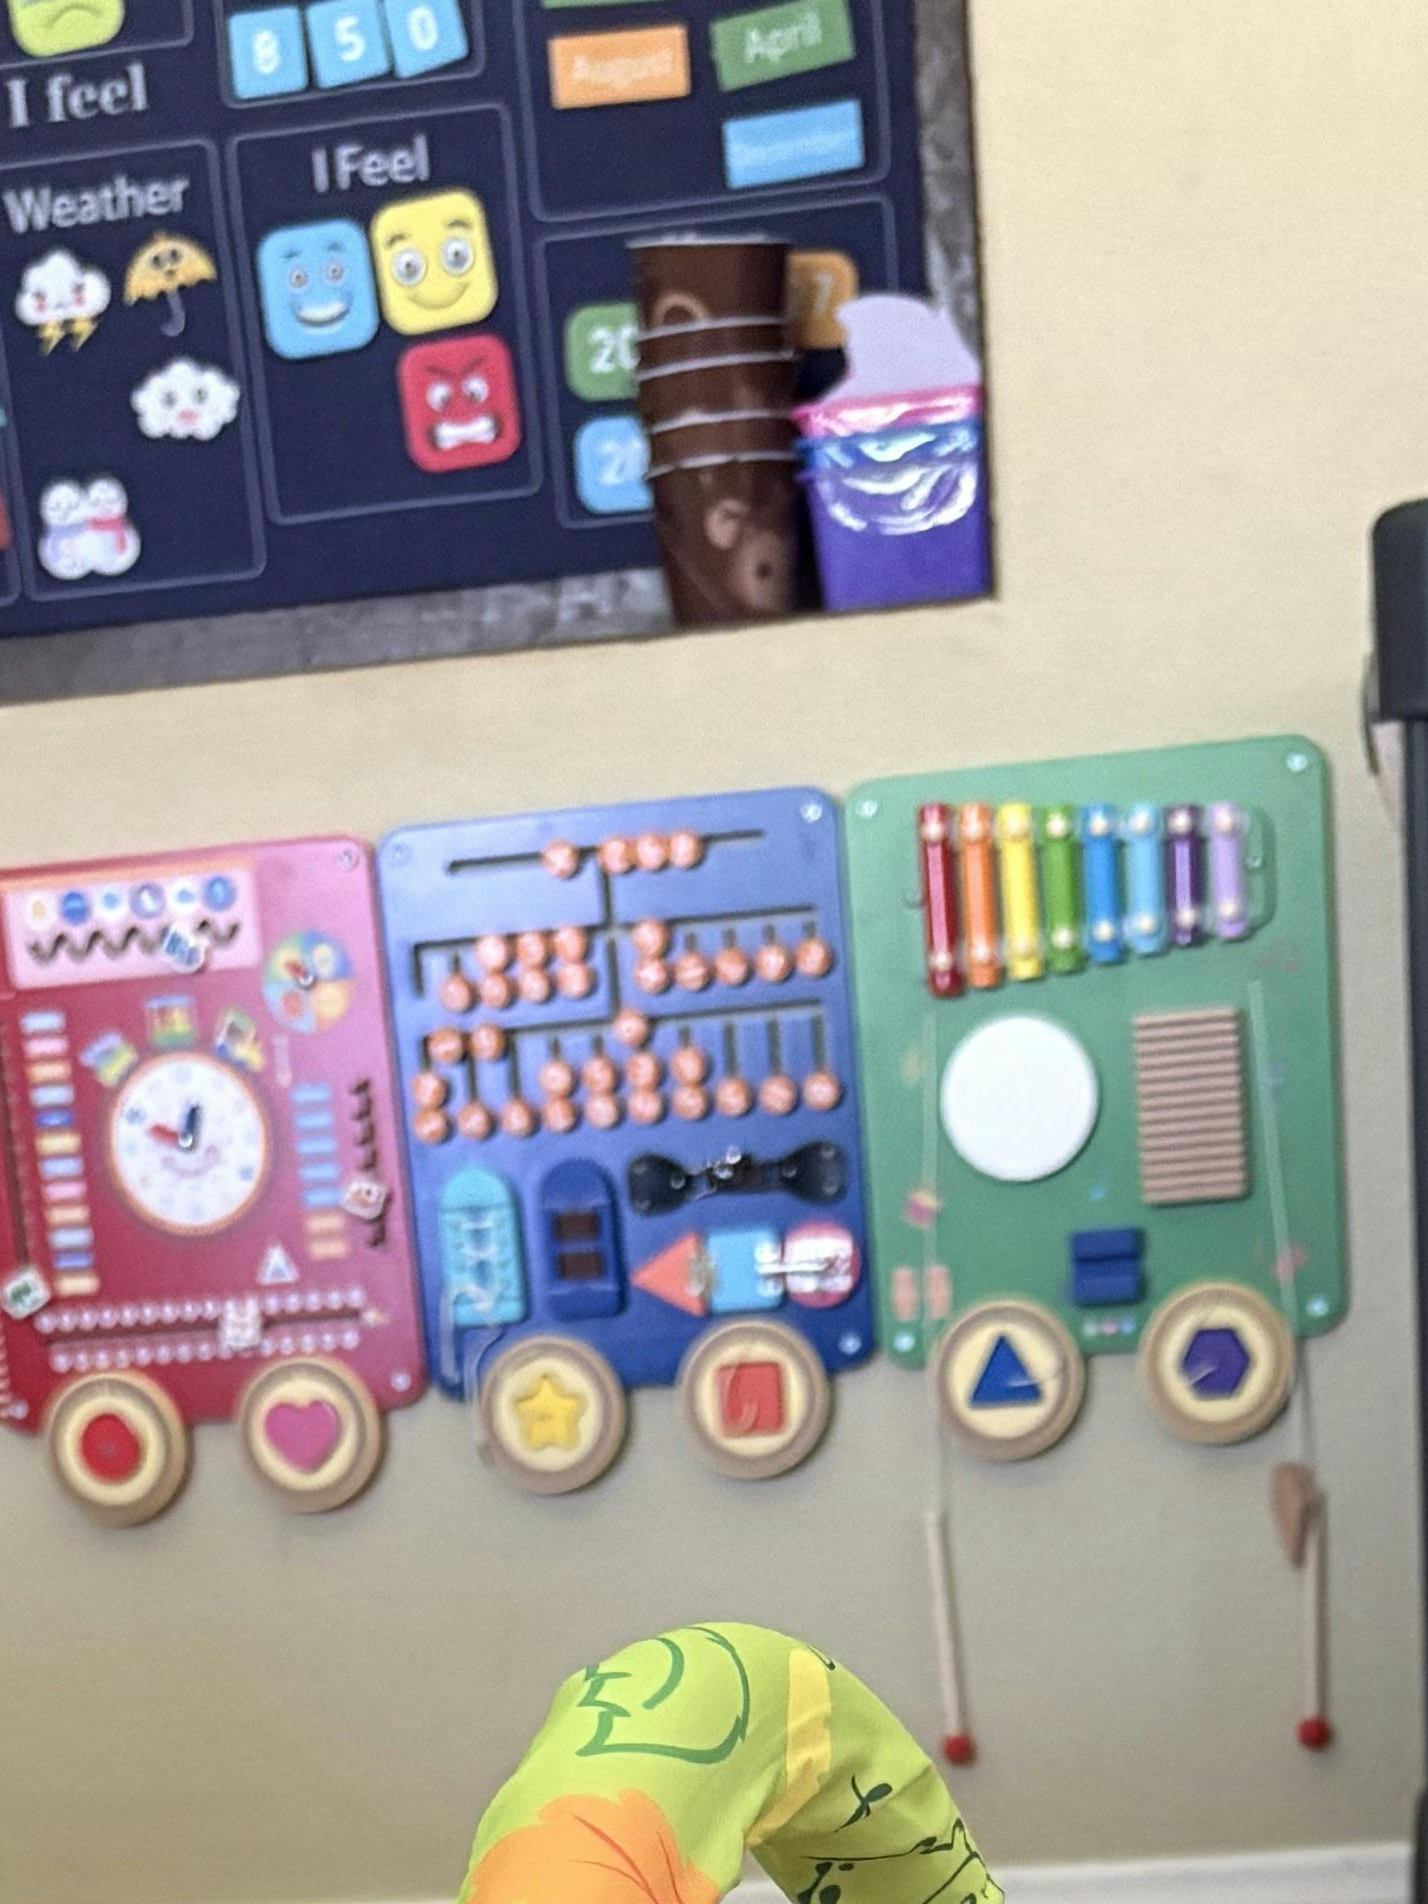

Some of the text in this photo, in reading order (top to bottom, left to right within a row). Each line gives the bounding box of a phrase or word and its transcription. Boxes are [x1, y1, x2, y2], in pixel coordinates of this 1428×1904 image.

[334, 15, 365, 61] 5
[406, 6, 439, 50] 0
[744, 10, 823, 64] April
[6, 60, 150, 128] I feel
[312, 133, 431, 194] I Feel
[2, 173, 190, 233] Weather
